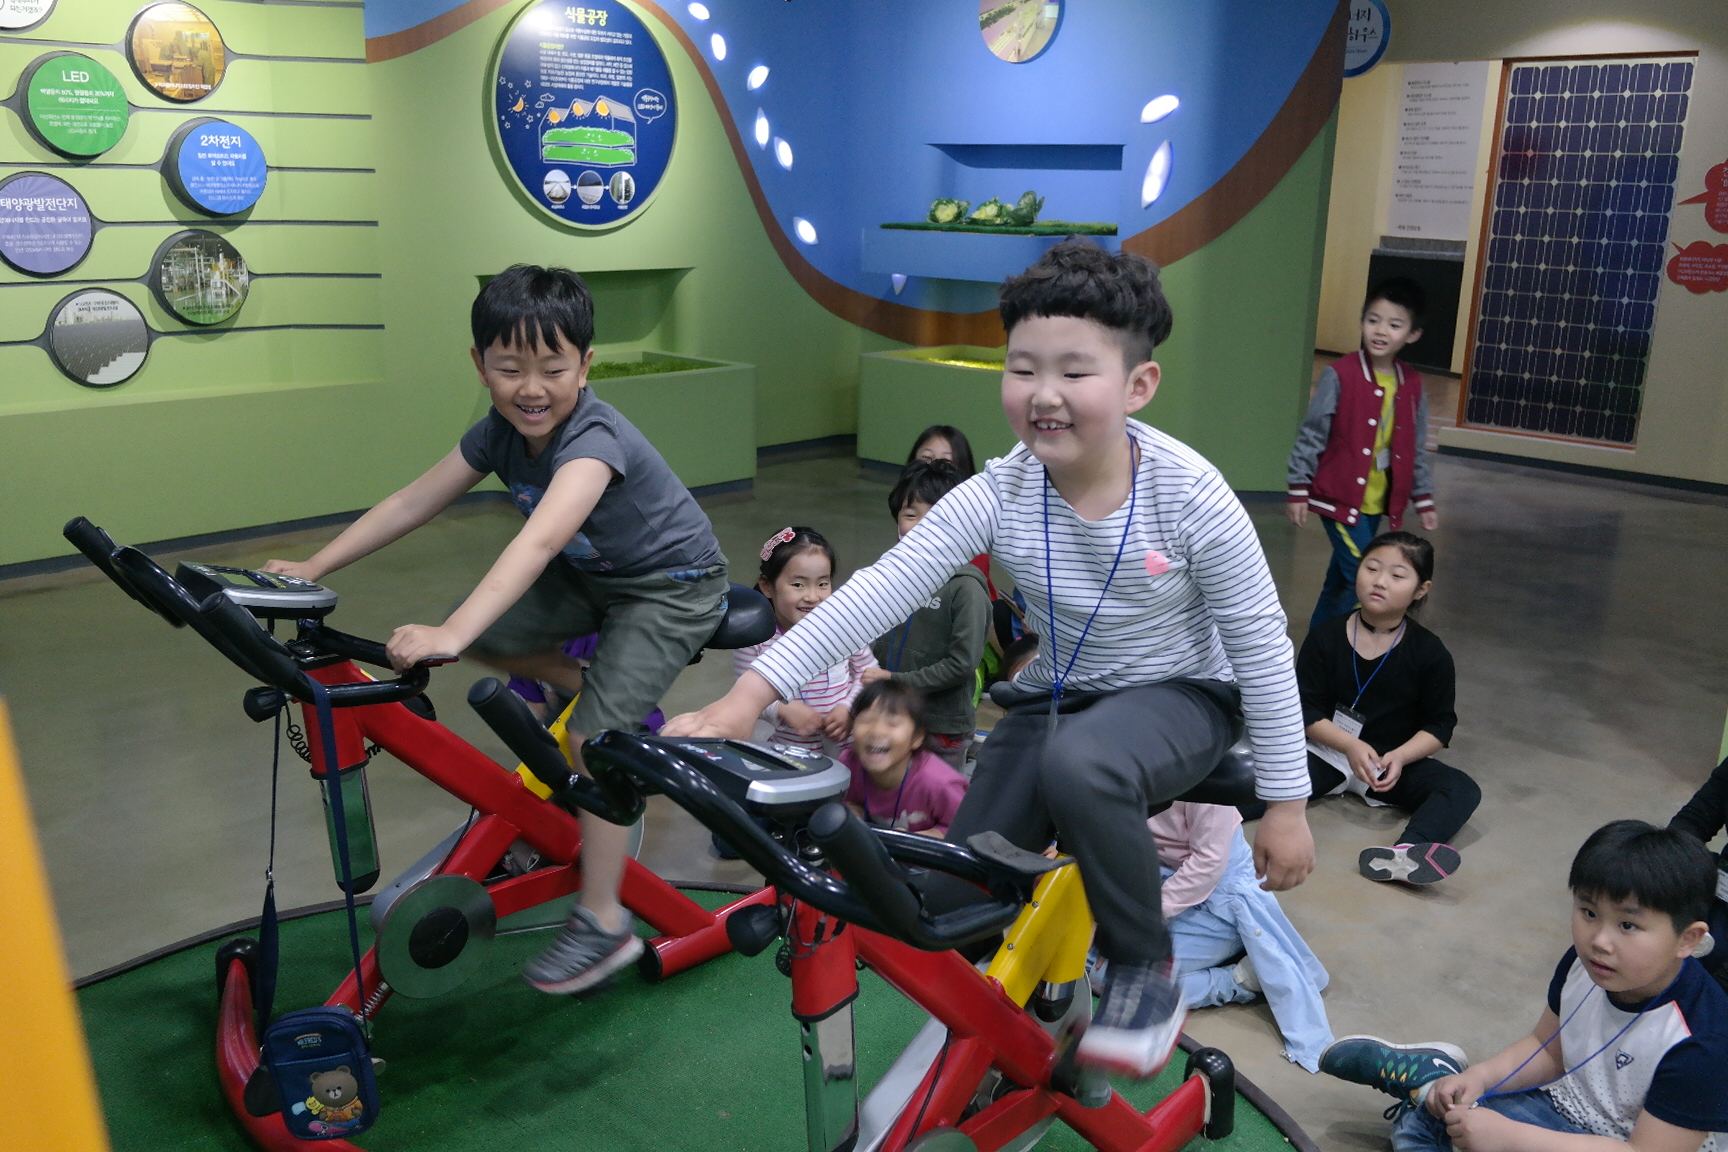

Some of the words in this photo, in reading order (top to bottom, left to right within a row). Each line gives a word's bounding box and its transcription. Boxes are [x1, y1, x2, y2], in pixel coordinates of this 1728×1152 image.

[564, 6, 608, 26] 식물공장
[62, 70, 90, 83] LED
[200, 134, 242, 149] 2차전지
[0, 197, 78, 212] 태양광발전단지
